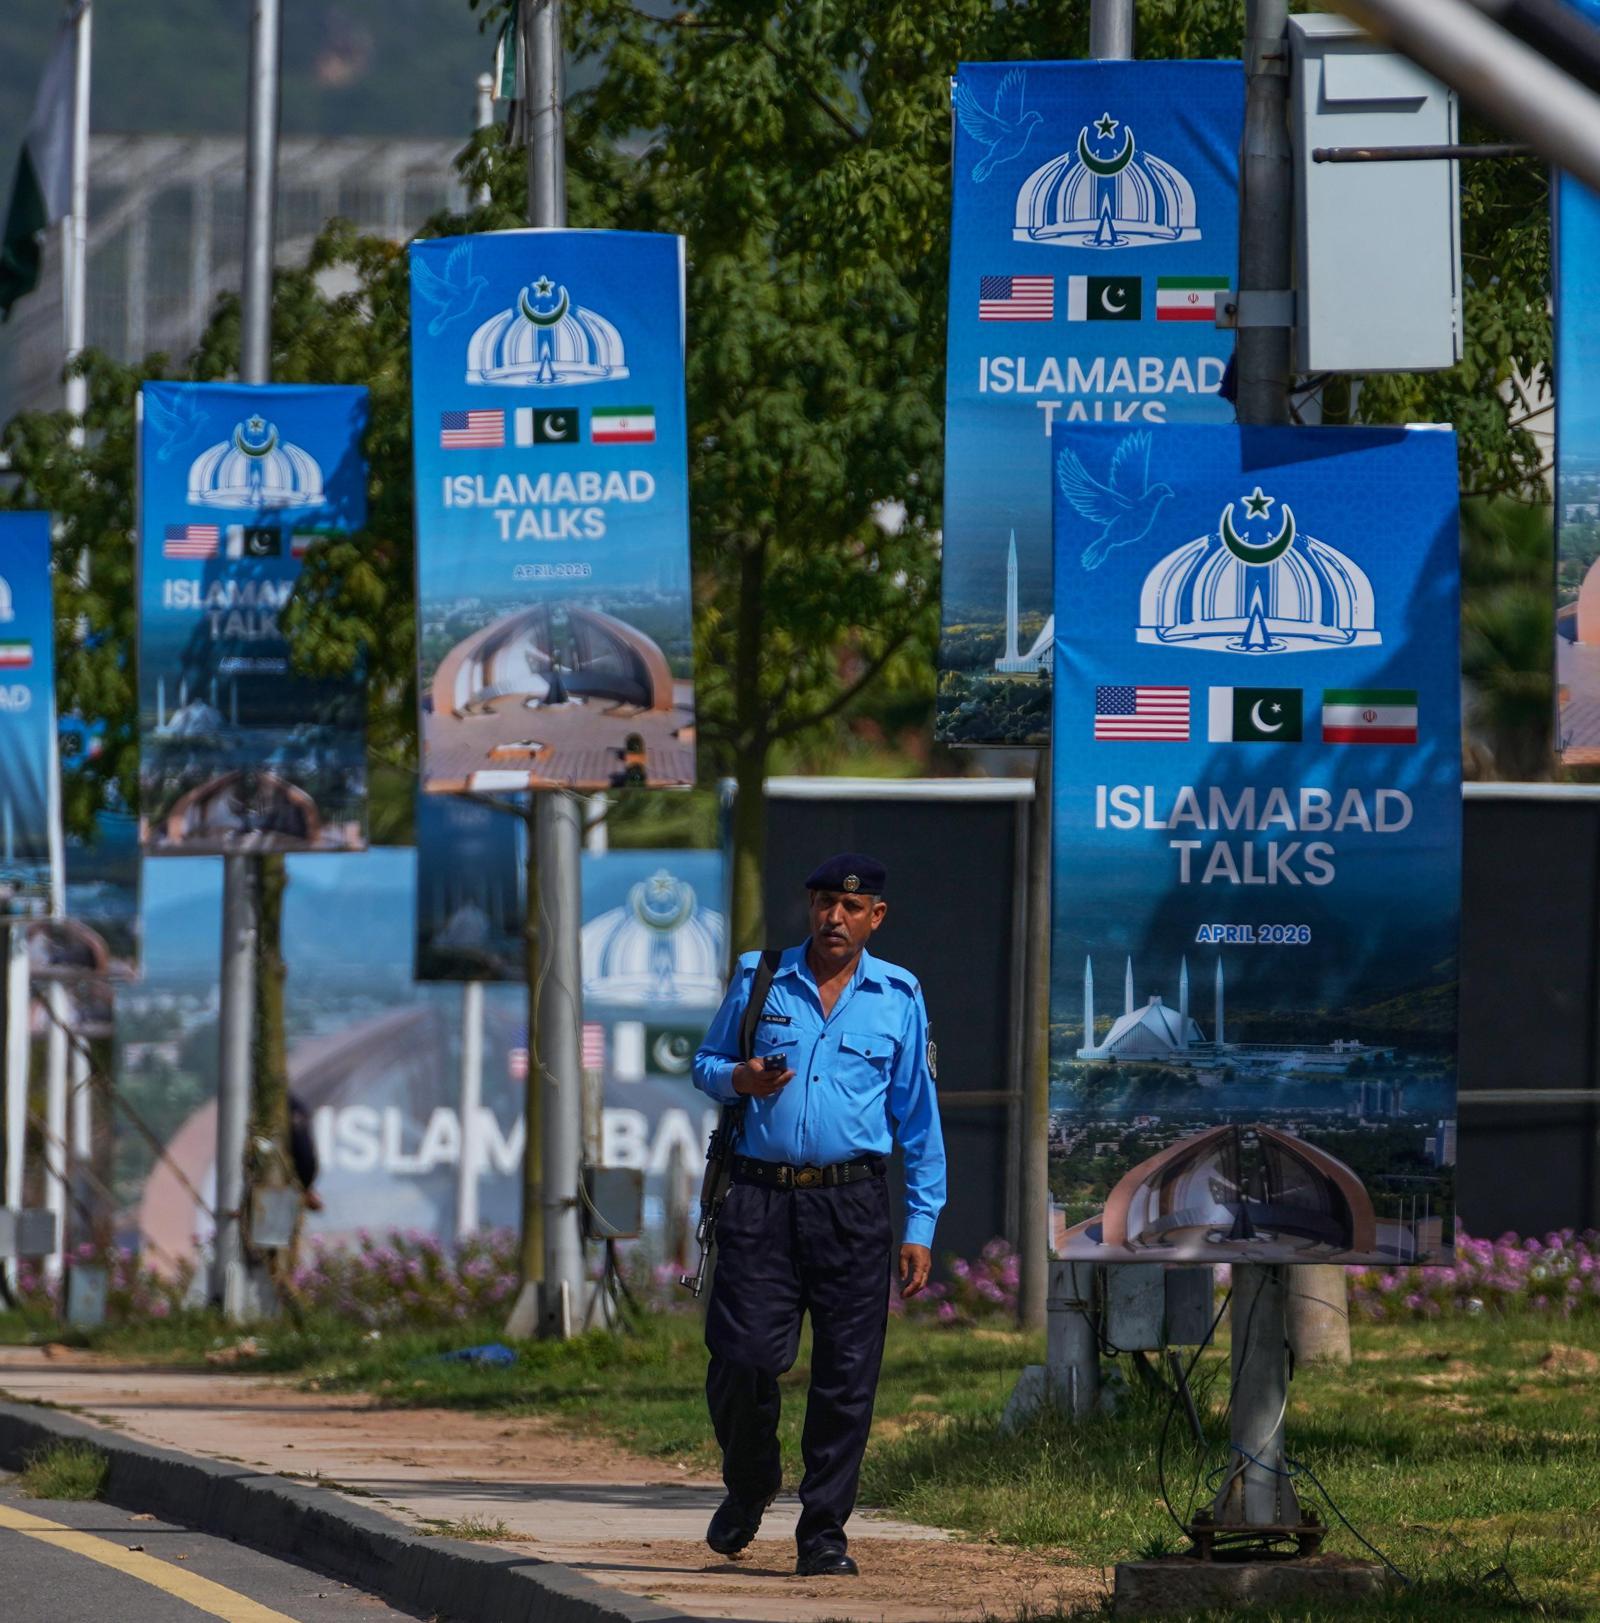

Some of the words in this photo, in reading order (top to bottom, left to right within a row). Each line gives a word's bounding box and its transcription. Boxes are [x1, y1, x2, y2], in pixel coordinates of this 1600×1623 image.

[979, 357, 1226, 393] ISLAMABAD
[442, 470, 656, 507] ISLAMABAD
[493, 507, 607, 541] TALKS
[163, 578, 297, 610] ISLAMA
[208, 609, 298, 641] TALK
[1096, 784, 1414, 833] ISLAMABAD
[1169, 840, 1336, 886] TALKS
[1196, 923, 1256, 944] APRIL
[1260, 924, 1312, 944] 2026
[312, 1104, 719, 1175] ISLAMBA
